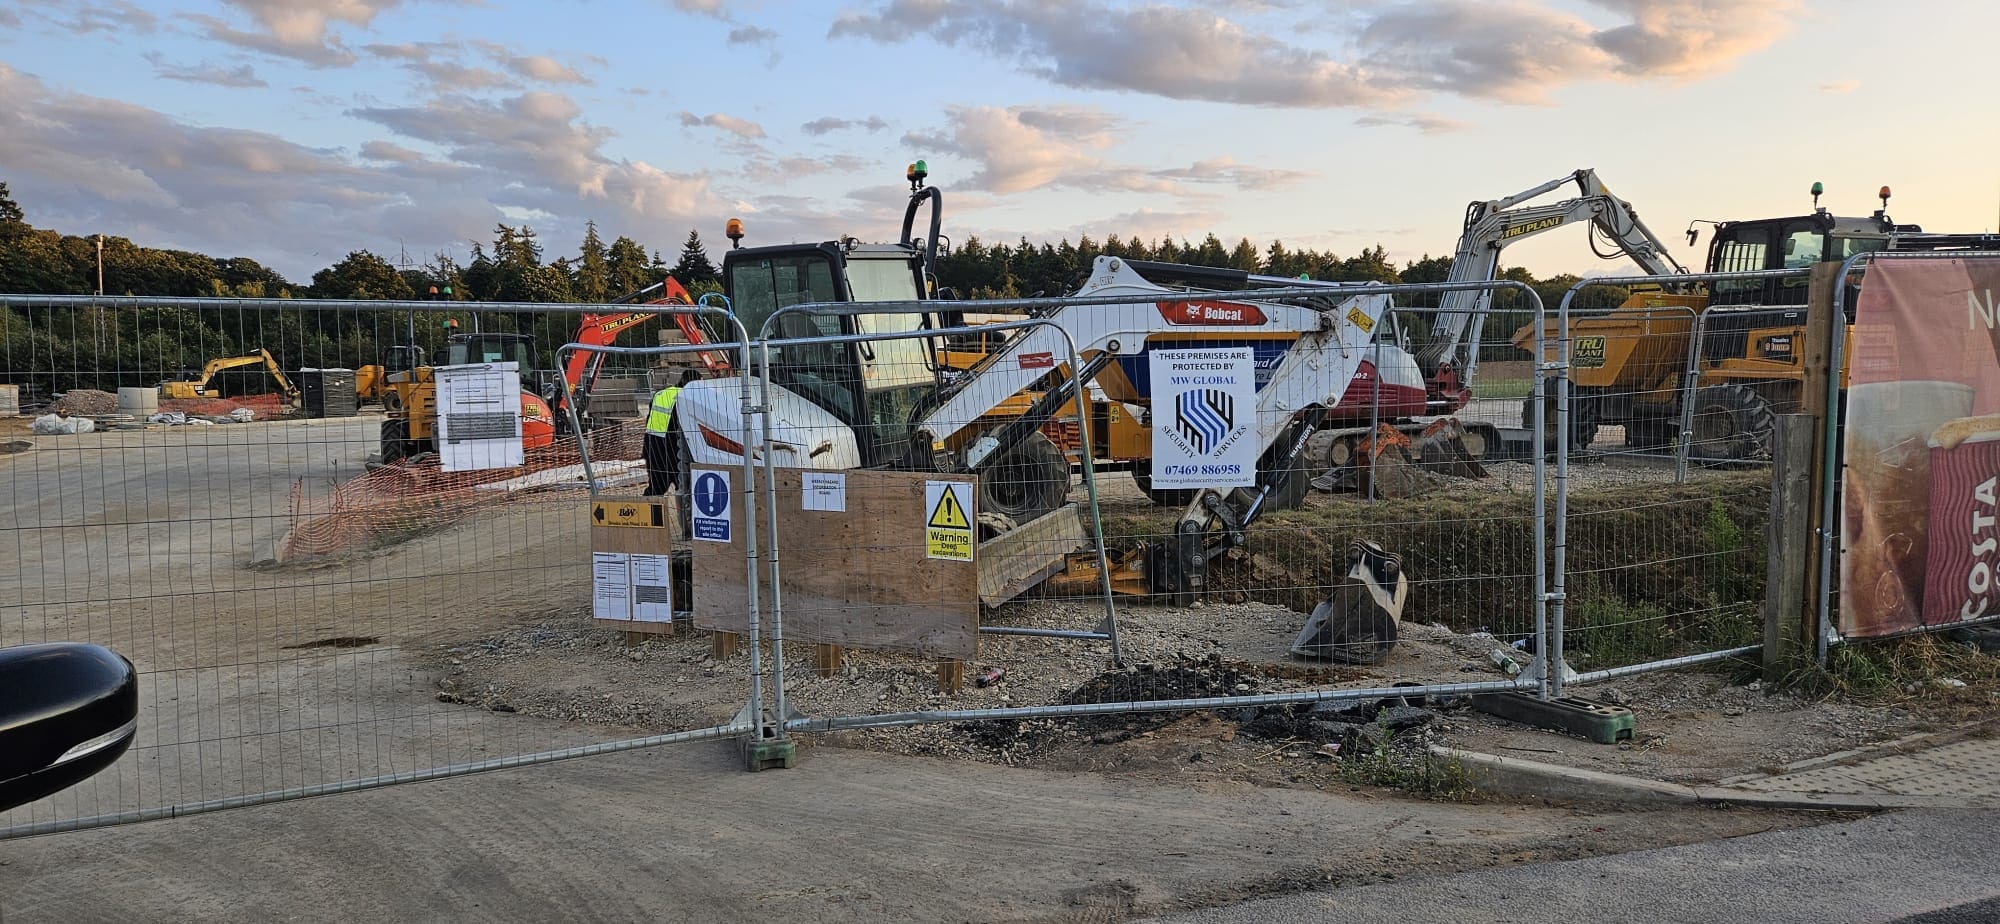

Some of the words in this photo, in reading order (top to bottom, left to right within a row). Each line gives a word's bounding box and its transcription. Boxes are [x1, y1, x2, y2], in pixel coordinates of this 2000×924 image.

[1505, 225, 1525, 238] TRU
[1526, 216, 1560, 231] PLANT
[1204, 306, 1242, 321] Bobcat
[1968, 288, 2000, 330] N
[603, 320, 621, 331] TRU
[1576, 338, 1604, 350] TRU
[1160, 352, 1186, 360] THESE
[1188, 352, 1229, 360] PREMISES
[1231, 352, 1247, 360] ARE
[1172, 363, 1222, 371] PROTECTED
[1223, 362, 1234, 370] BY
[1171, 376, 1191, 385] MW
[1193, 376, 1237, 385] GLOBAL
[1162, 425, 1195, 460] SECURITY
[1213, 425, 1247, 460] SERVICES
[1165, 465, 1198, 475] 07469
[1201, 464, 1241, 475] 886958
[930, 531, 968, 545] Warning
[941, 543, 957, 551] Deep
[1961, 476, 1997, 620] COSTA
